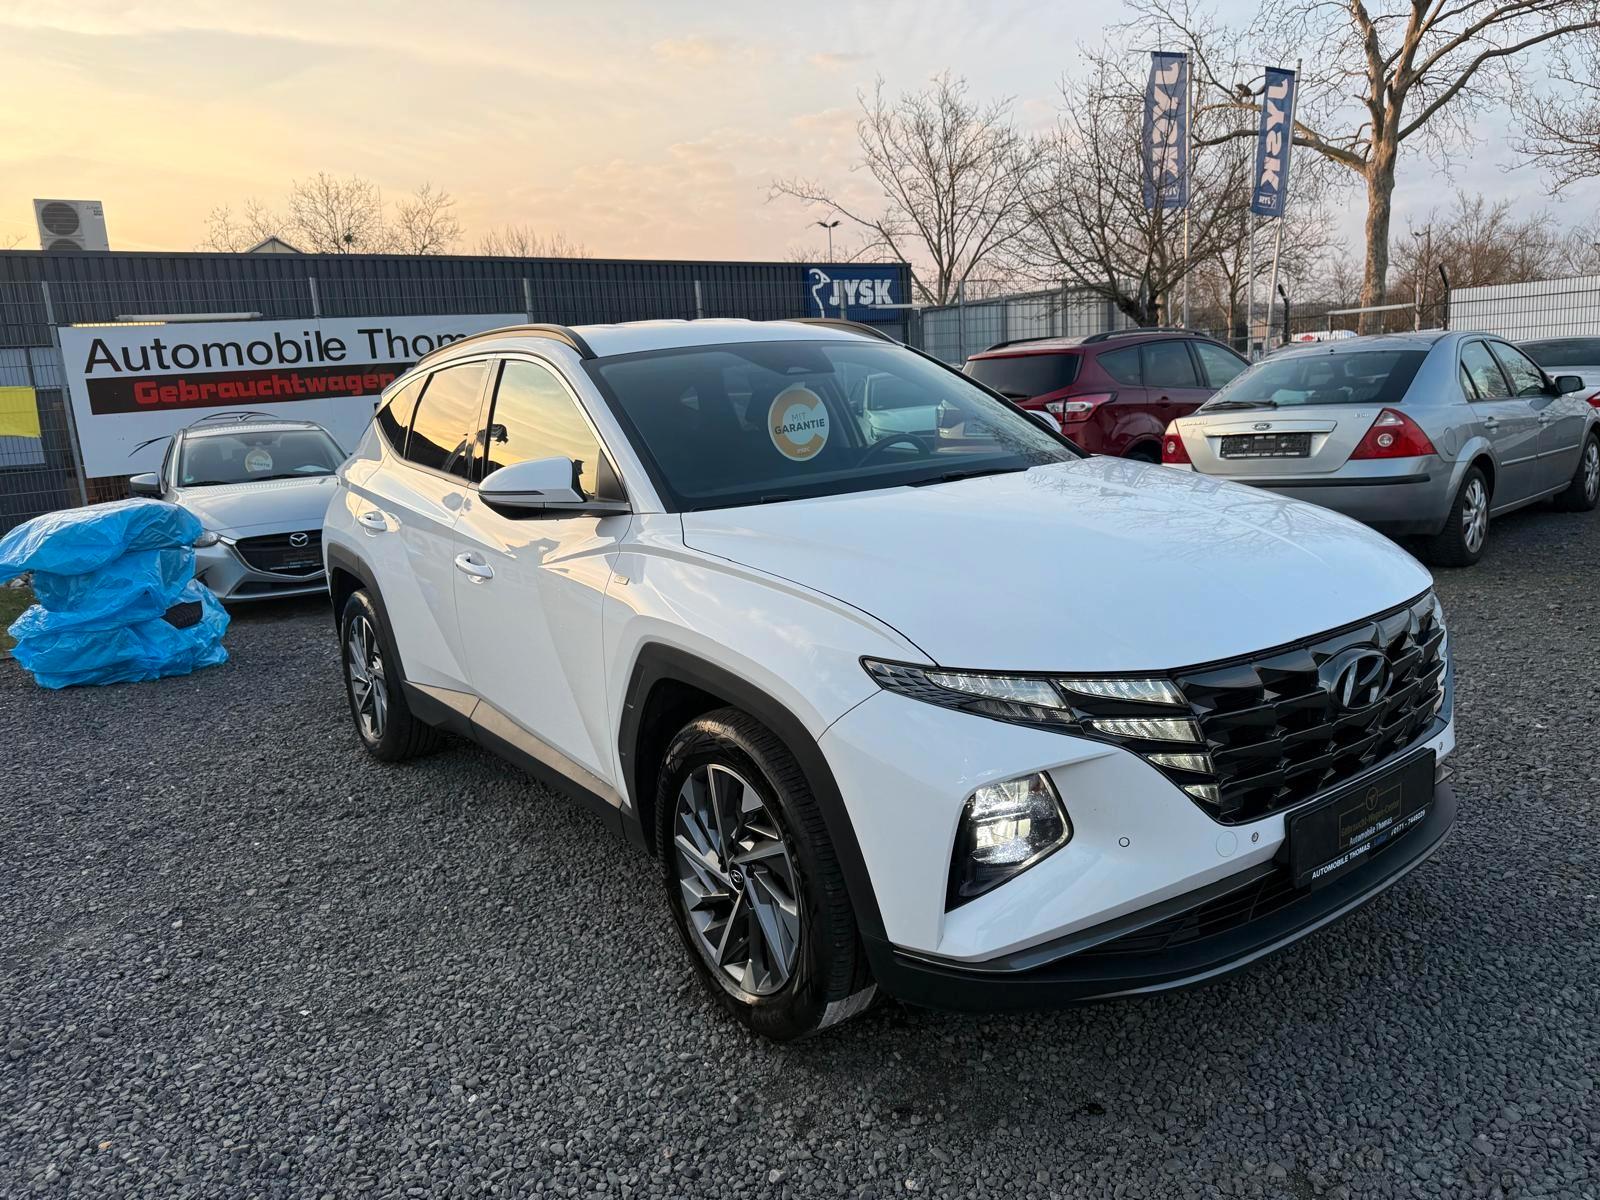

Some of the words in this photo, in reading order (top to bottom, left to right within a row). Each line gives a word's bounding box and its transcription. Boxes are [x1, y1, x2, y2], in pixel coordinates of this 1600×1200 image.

[829, 279, 893, 305] JYSK
[84, 330, 347, 374] Automobile
[133, 372, 396, 405] Gebrauchtwagen
[774, 418, 825, 435] GARANTIE
[791, 412, 806, 421] MIT
[1349, 826, 1376, 846] Automobile
[1311, 854, 1349, 880] AUTOMOBILE
[1349, 842, 1371, 860] THOMAS
